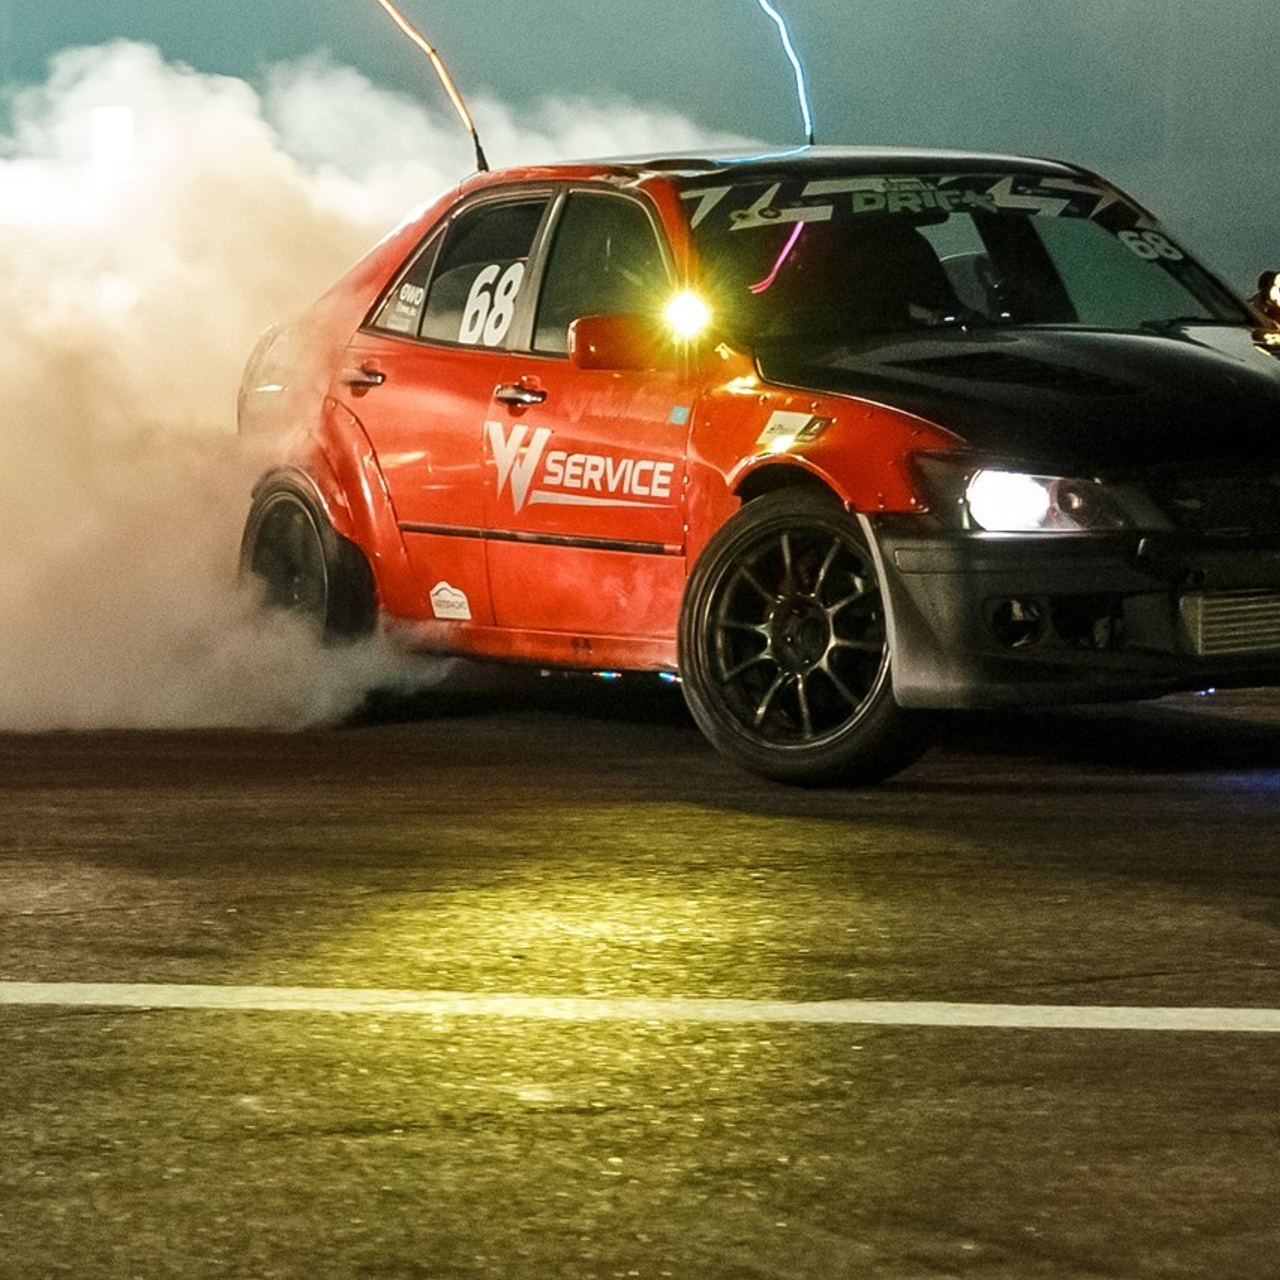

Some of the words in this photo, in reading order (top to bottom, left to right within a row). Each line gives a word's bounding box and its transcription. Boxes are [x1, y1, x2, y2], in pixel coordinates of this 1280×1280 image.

[1118, 230, 1184, 260] 68
[458, 262, 525, 347] 68
[543, 450, 675, 497] SERVICE
